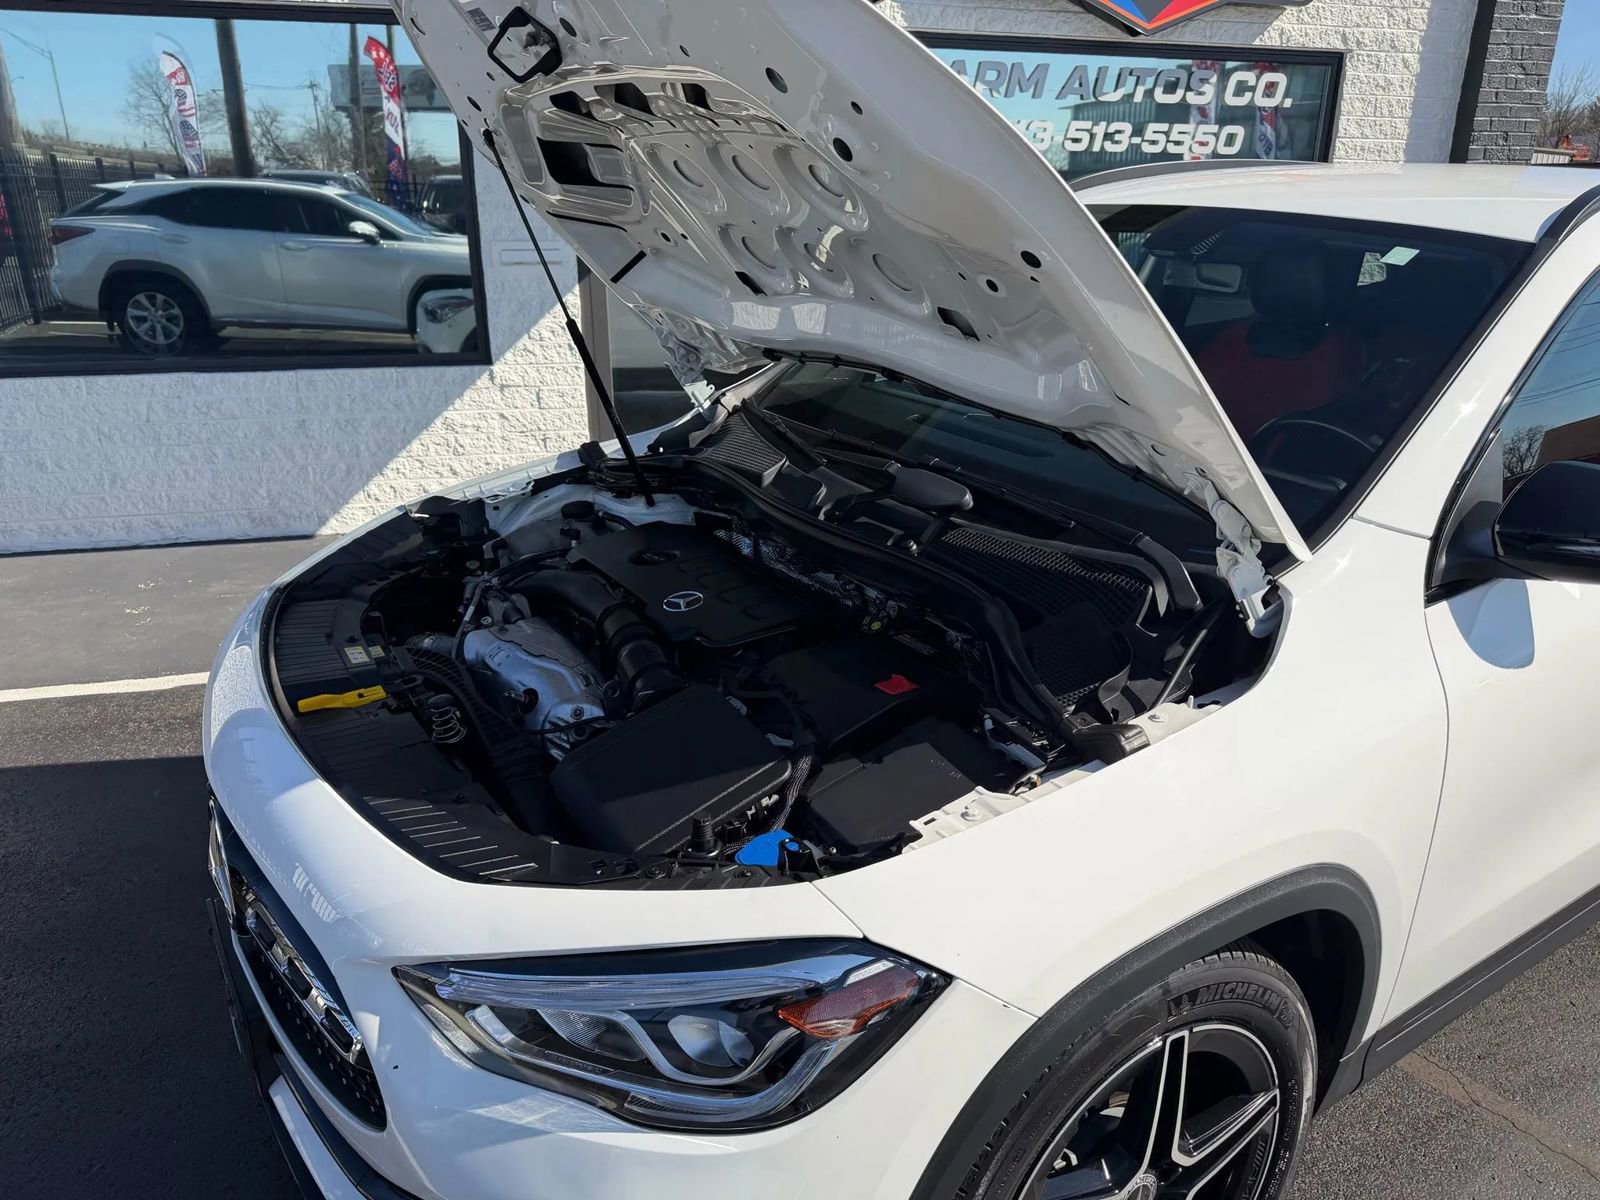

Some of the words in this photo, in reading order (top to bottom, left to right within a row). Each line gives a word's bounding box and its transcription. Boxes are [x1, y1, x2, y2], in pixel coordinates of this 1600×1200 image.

[1055, 64, 1217, 105] AUTOS
[1224, 71, 1293, 108] CO.
[1195, 982, 1281, 1014] MICHELIN
